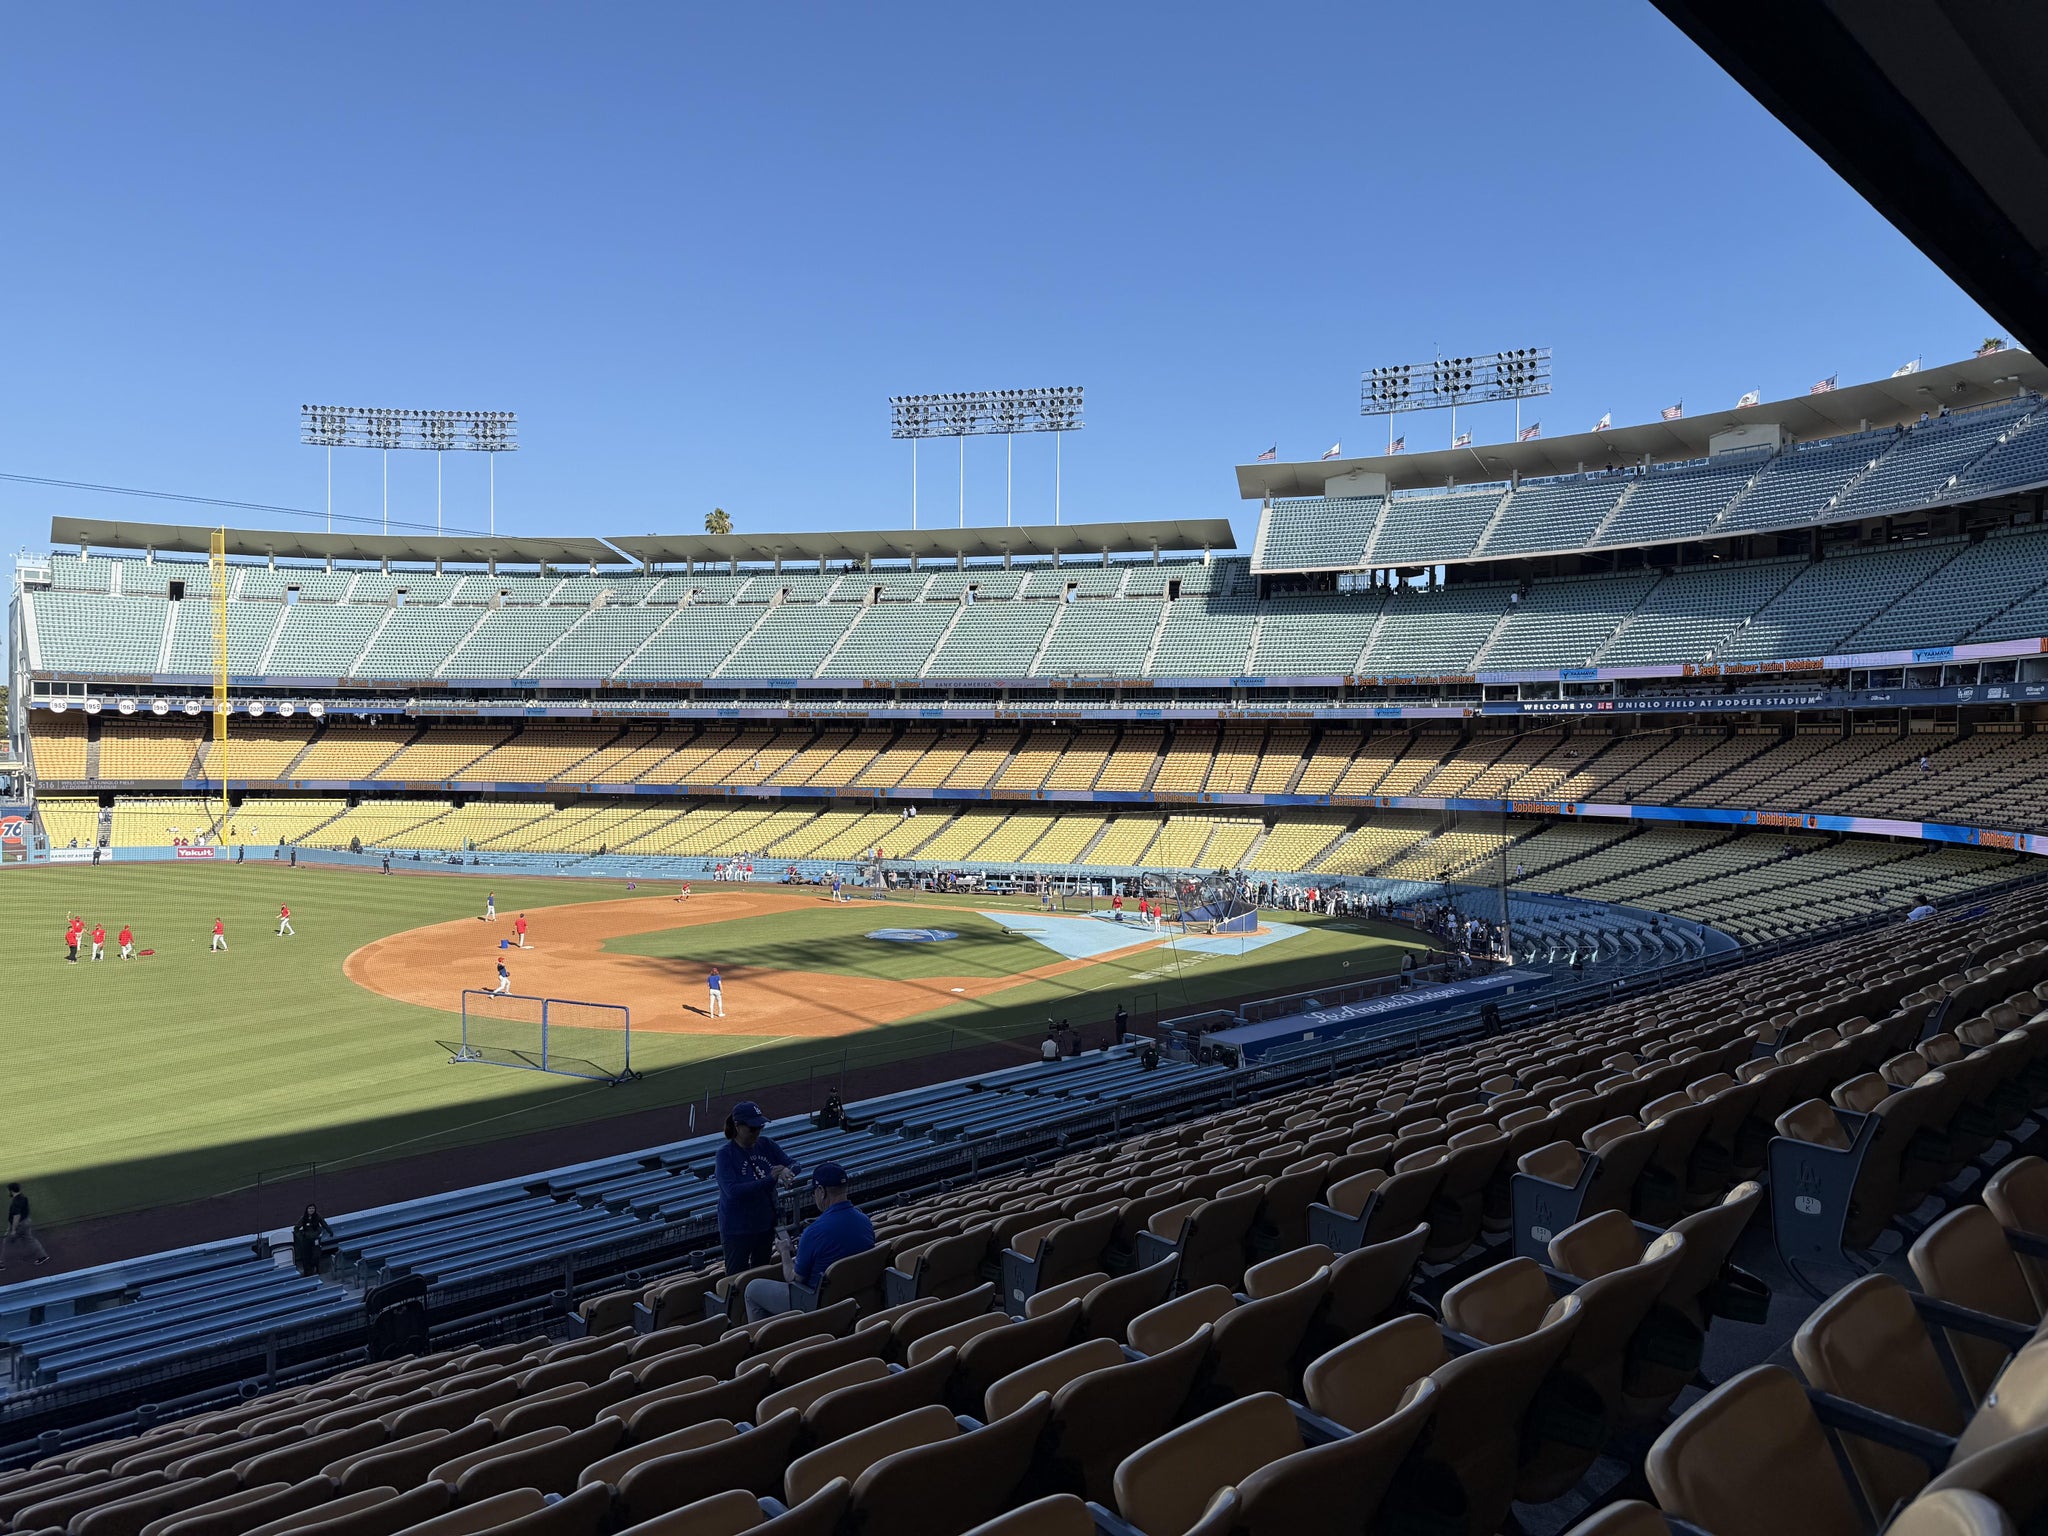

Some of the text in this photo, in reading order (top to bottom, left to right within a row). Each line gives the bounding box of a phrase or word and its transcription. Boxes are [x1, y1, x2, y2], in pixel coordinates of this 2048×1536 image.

[1699, 663, 1720, 675] Seeds
[1725, 664, 1758, 674] Sunflower
[1760, 662, 1783, 673] Tossing
[1785, 658, 1824, 671] Bobblehead
[1359, 676, 1378, 686] Seeds
[1382, 675, 1413, 685] Sunflower
[1523, 702, 1575, 711] WELCOME
[1617, 701, 1661, 709] UNIQLO
[1766, 697, 1816, 705] STADIUM
[1513, 801, 1560, 814] Bobblehead
[1757, 811, 1802, 827] Bobblehead
[2, 821, 23, 837] 76
[1979, 829, 2015, 849] Bobblehead
[179, 849, 213, 857] Yakult
[1338, 1000, 1402, 1016] Angeles
[1392, 987, 1465, 1005] Dodgers
[1802, 1196, 1813, 1204] 151
